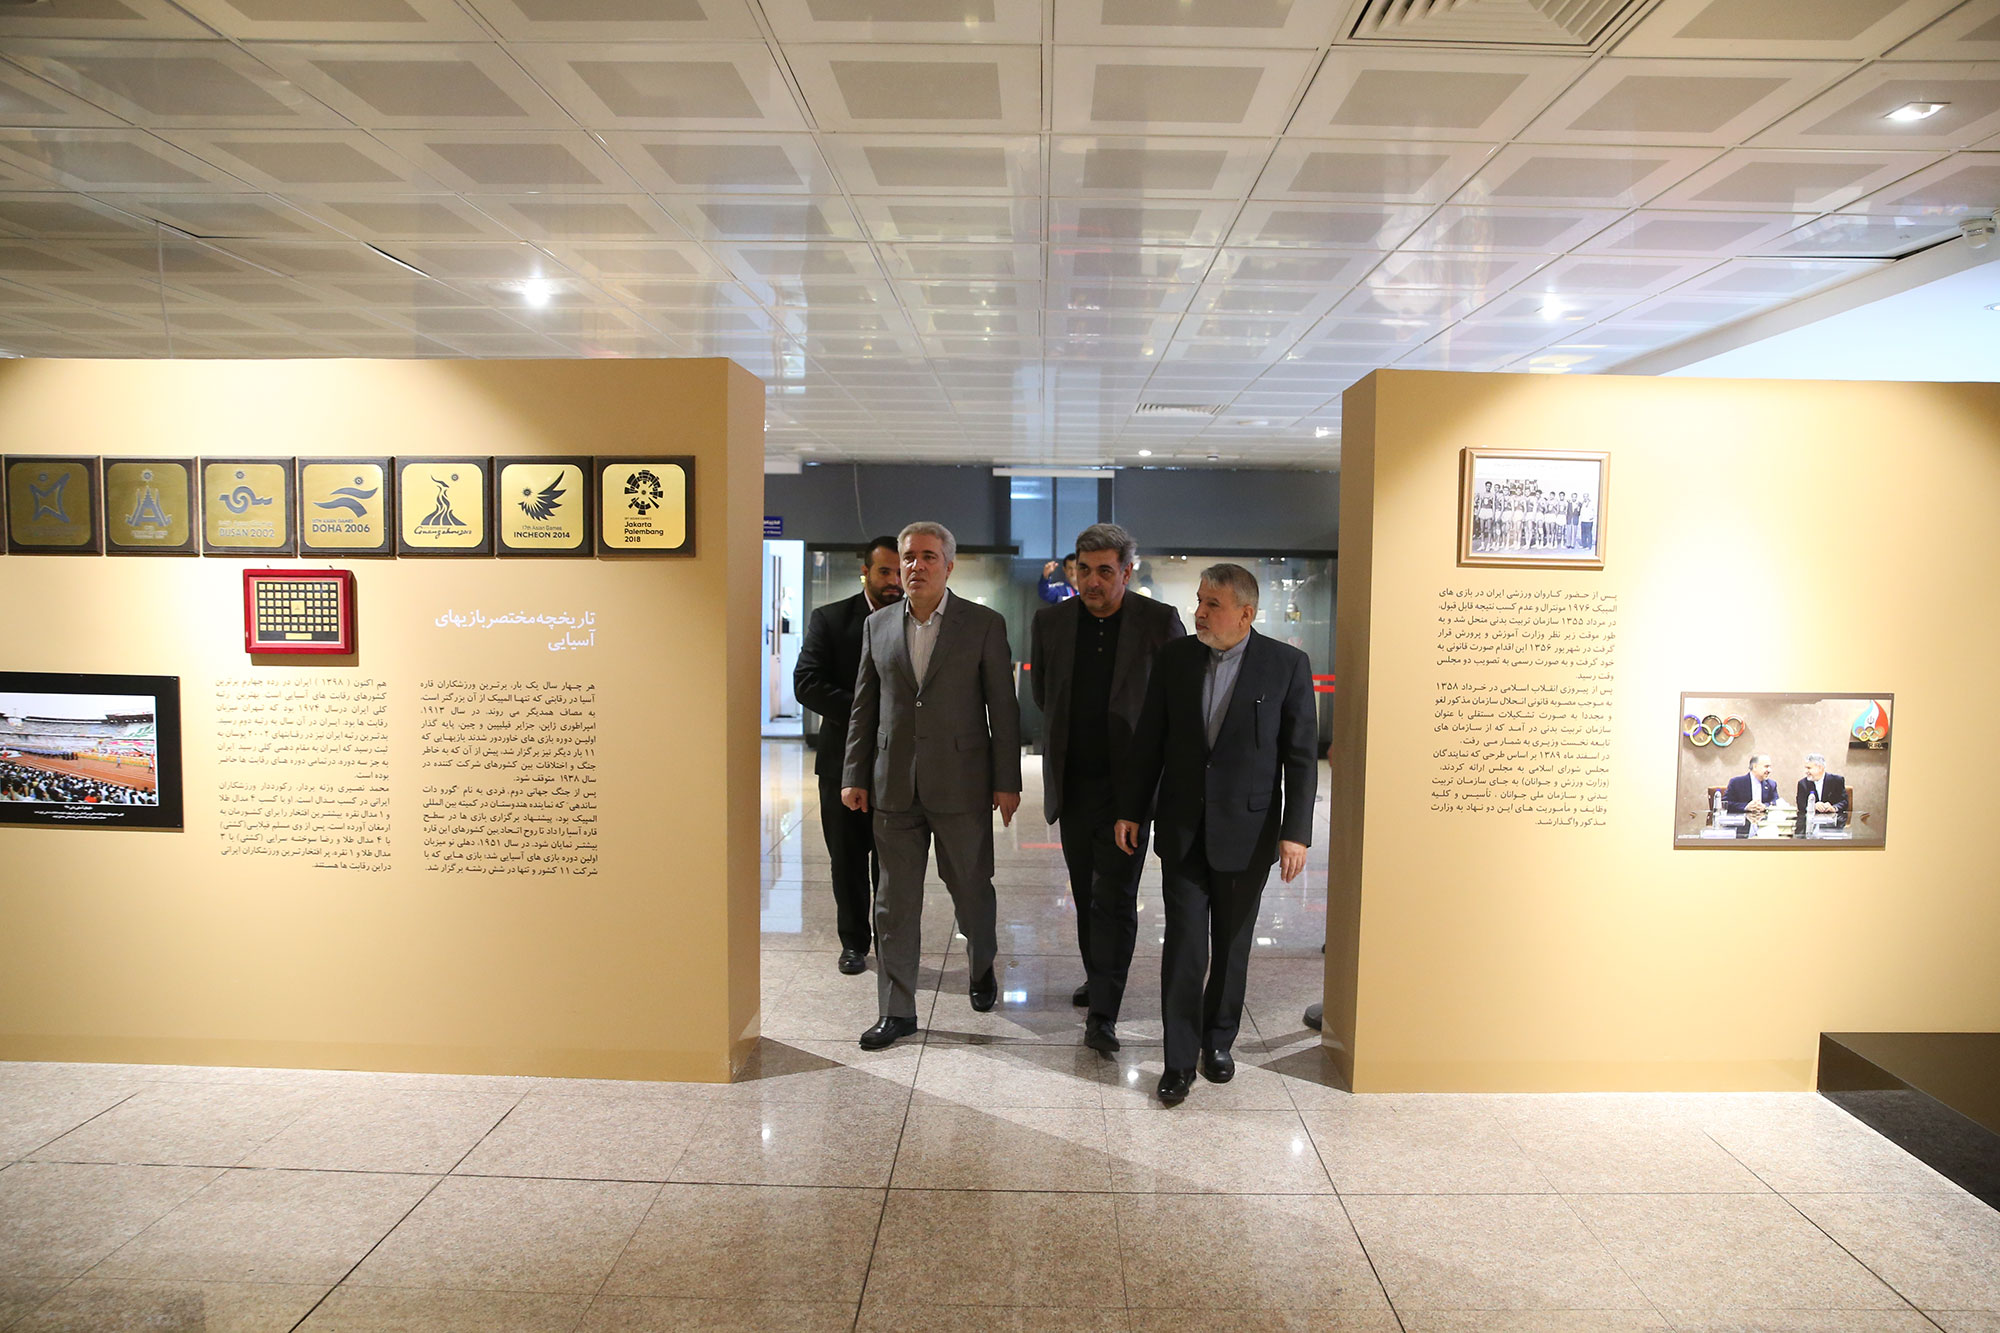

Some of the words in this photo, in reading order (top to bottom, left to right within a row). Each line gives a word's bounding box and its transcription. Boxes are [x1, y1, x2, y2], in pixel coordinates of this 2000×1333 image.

[219, 528, 249, 537] BUSAN
[250, 528, 275, 538] 2002
[312, 524, 342, 533] DOHA
[345, 524, 371, 533] 2006
[624, 528, 664, 536] Palembang
[1439, 588, 1454, 598] های
[1456, 588, 1473, 598] بازی
[1474, 590, 1484, 598] در
[1486, 589, 1505, 599] ایران
[1506, 590, 1532, 600] ورزشی
[1533, 590, 1562, 600] کاروان
[1592, 591, 1599, 600] از
[1458, 601, 1474, 612] قابل
[1475, 603, 1494, 612] نتیجه
[1495, 602, 1517, 613] کسب
[1518, 605, 1533, 614] عدم
[1540, 603, 1566, 614] مونترال
[1568, 603, 1590, 612] ۱۹۷۶
[434, 608, 486, 628] بازیهای
[486, 610, 536, 628] مختصر
[536, 611, 596, 629] تاریخچه
[1438, 617, 1446, 625] به
[1467, 615, 1488, 626] منحل
[1489, 616, 1507, 626] بدنی
[1509, 617, 1531, 627] تربیت
[1532, 617, 1559, 626] سازمان
[1562, 617, 1584, 625] ۱۳۵۵
[1586, 618, 1606, 628] مرداد
[1607, 620, 1617, 628] در
[1437, 628, 1452, 639] قرار
[1455, 629, 1481, 639] پرورش
[1492, 628, 1519, 640] آموزش
[1521, 630, 1545, 640] وزارت
[1548, 630, 1561, 641] نظر
[1563, 632, 1576, 641] زیر
[1579, 631, 1599, 641] موقت
[1602, 632, 1616, 642] طور
[547, 629, 597, 651] آسیایی
[1437, 644, 1445, 652] به
[1446, 642, 1468, 653] قانونی
[1469, 644, 1494, 653] صورت
[1495, 643, 1514, 654] اقدام
[1515, 643, 1528, 654] این
[1530, 643, 1551, 652] ۱۳۵۶
[1554, 645, 1580, 654] شهریور
[1593, 644, 1615, 655] گرفت
[1436, 655, 1461, 666] مجلس
[1463, 658, 1472, 666] دو
[1473, 657, 1500, 666] تصویب
[1502, 658, 1509, 666] به
[1535, 658, 1559, 667] صورت
[1575, 657, 1598, 668] گرفت
[1600, 660, 1614, 668] خود
[420, 680, 434, 689] قاره
[437, 680, 476, 690] ورزشکاران
[479, 681, 507, 691] برترین
[525, 681, 539, 691] یک
[542, 681, 558, 690] سال
[586, 684, 595, 692] هر
[467, 692, 477, 703] آن
[479, 693, 486, 703] از
[514, 694, 530, 704] تنها
[532, 694, 543, 702] که
[544, 695, 567, 705] رقابتی
[569, 697, 578, 705] در
[579, 693, 595, 705] آسیا
[450, 706, 466, 715] سال
[526, 706, 554, 718] همدیگر
[559, 708, 583, 716] مصاف
[421, 718, 438, 729] گذار
[441, 720, 455, 730] پایه
[515, 721, 535, 731] جزایر
[421, 732, 431, 740] که
[520, 734, 535, 744] های
[537, 734, 554, 745] بازی
[556, 737, 573, 745] دوره
[574, 735, 596, 746] اولین
[422, 746, 440, 756] خاطر
[441, 748, 449, 756] به
[450, 746, 461, 754] که
[462, 745, 473, 756] آن
[474, 746, 481, 756] از
[482, 748, 499, 757] پیش
[516, 746, 540, 758] برگزار
[541, 749, 551, 758] نیز
[553, 747, 571, 758] دیگر
[573, 748, 583, 758] بار
[585, 748, 595, 756] ۱۱
[433, 759, 453, 767] کننده
[456, 759, 481, 770] شرکت
[484, 760, 518, 770] کشورهای
[520, 763, 533, 771] بین
[536, 761, 567, 769] اختلافات
[577, 761, 596, 771] جنگ
[532, 774, 555, 784] متوقف
[560, 774, 580, 782] ۱۹۳۸
[581, 775, 597, 784] سال
